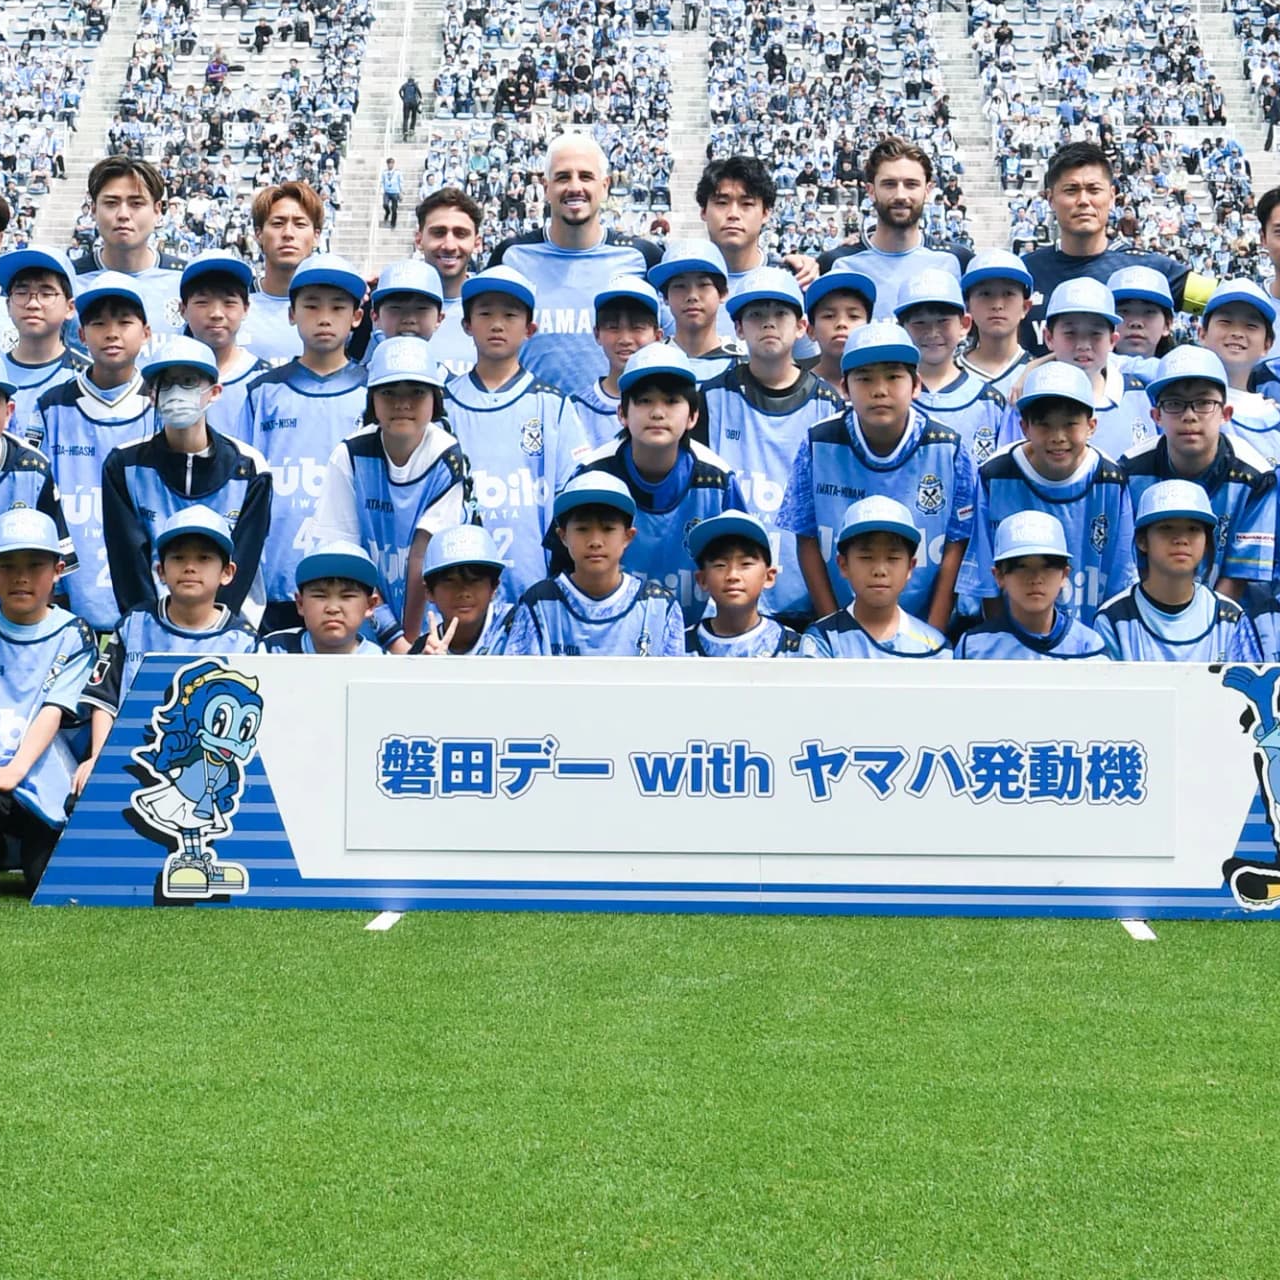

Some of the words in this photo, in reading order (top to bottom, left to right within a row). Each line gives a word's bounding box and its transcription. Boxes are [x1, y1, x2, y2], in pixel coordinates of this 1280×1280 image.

[379, 737, 611, 797] 磐田デー
[631, 742, 772, 796] with
[792, 741, 1145, 802] ヤマハ発動機
